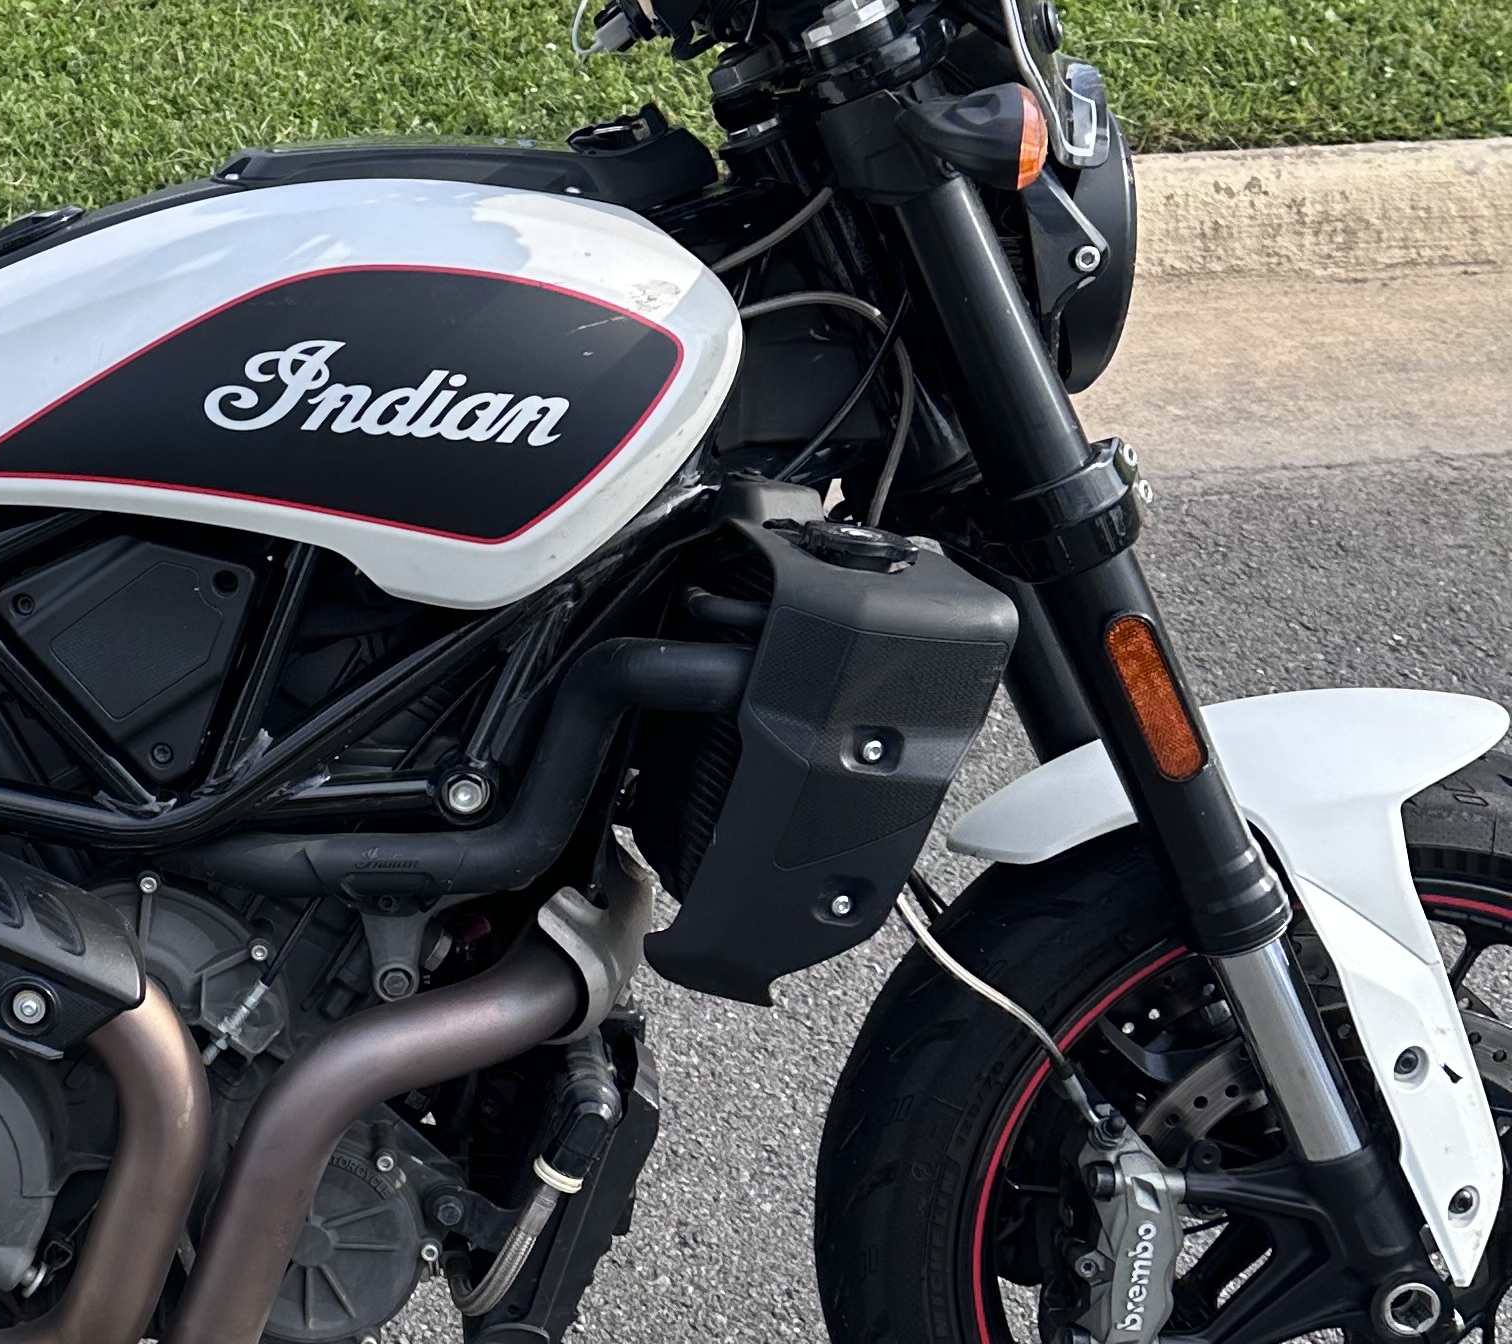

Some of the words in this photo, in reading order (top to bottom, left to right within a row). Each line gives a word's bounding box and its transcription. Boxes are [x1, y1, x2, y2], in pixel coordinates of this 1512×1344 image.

[204, 339, 570, 447] Indian
[929, 1169, 959, 1338] MICHELIN
[1116, 1221, 1157, 1331] brembo
